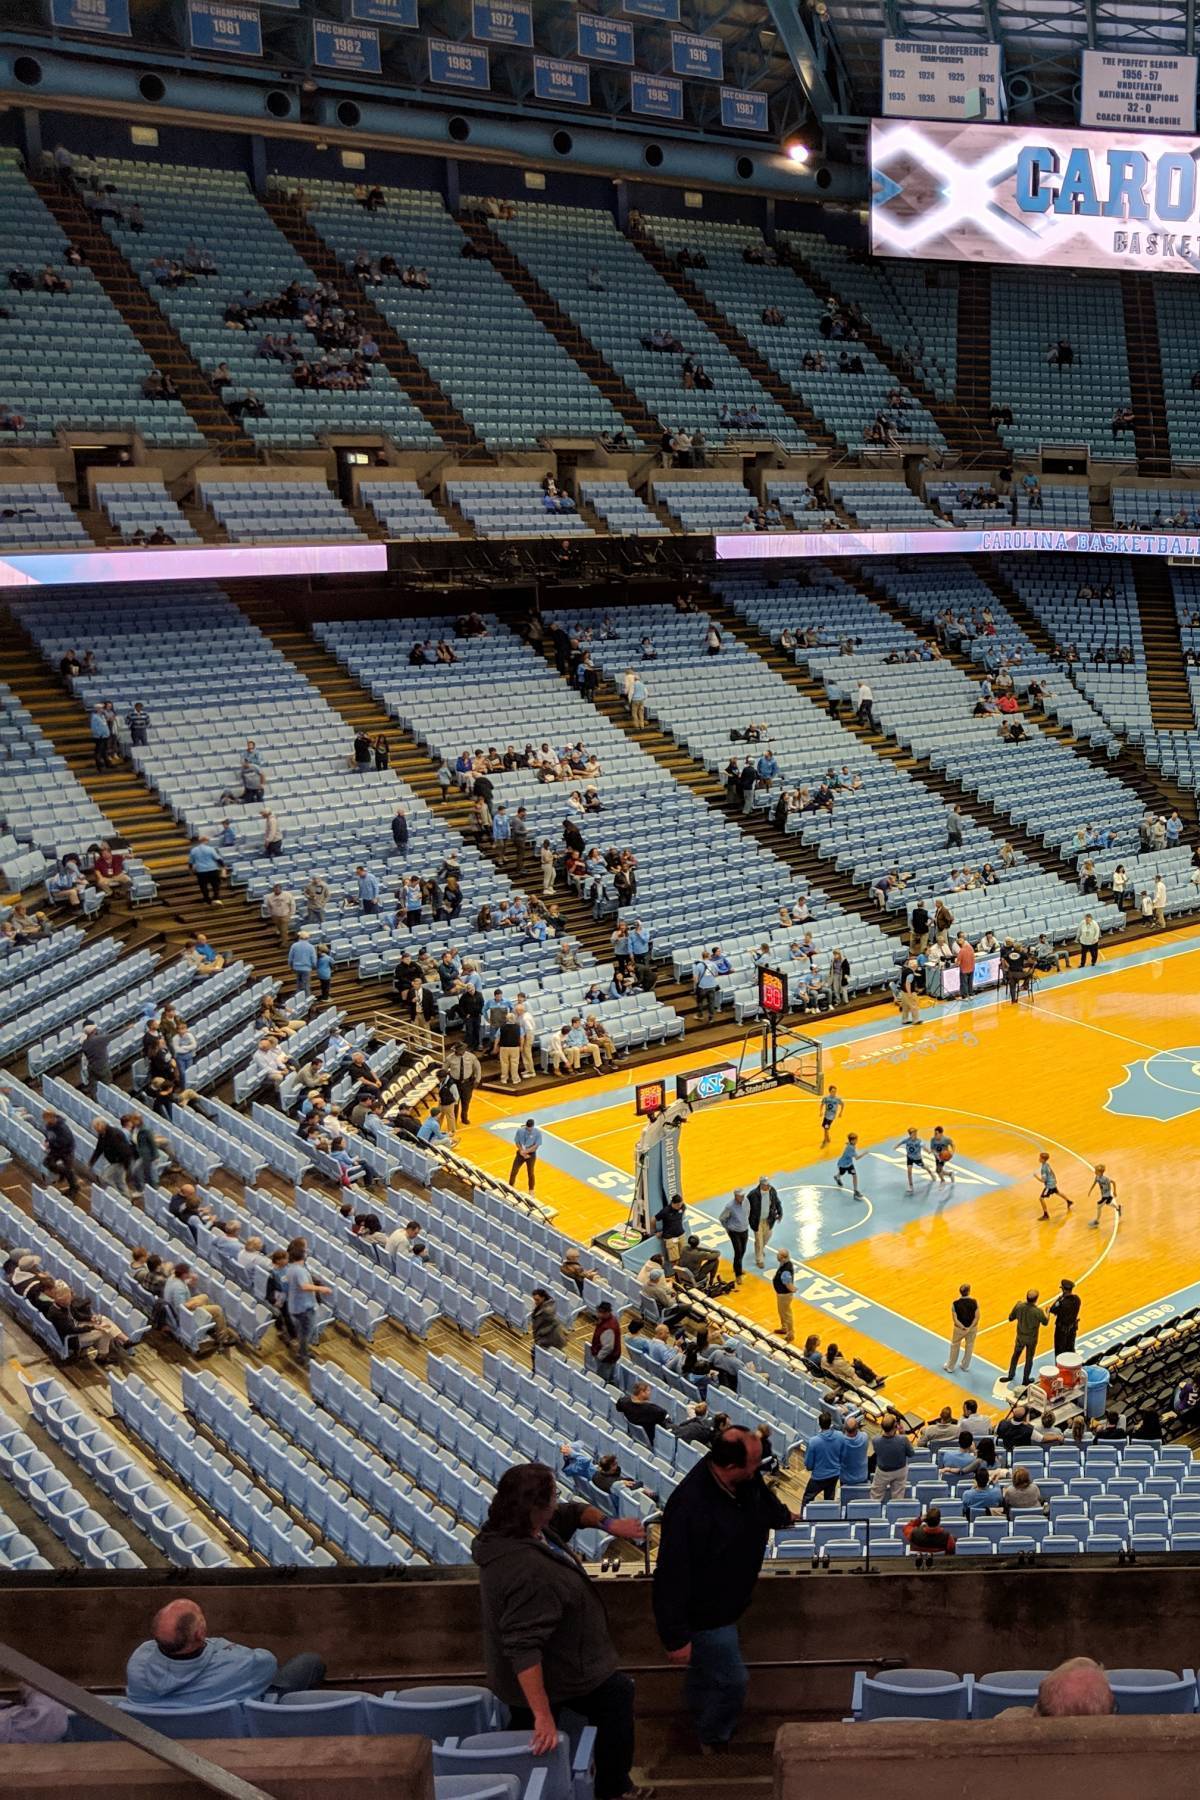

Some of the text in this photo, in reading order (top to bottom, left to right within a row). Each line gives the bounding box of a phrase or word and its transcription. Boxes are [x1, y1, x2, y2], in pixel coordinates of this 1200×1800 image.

[490, 12, 514, 28] 1972
[316, 23, 377, 41] ACC CHAMPIONS
[333, 37, 362, 54] 1982
[895, 42, 989, 57] SOUTHERN CONFERENCE
[1102, 57, 1178, 70] THE PERFECT SEASON
[889, 69, 905, 79] 1922
[1122, 69, 1142, 80] 1956
[1149, 70, 1159, 80] 57
[1117, 81, 1162, 91] UNDEFEATED
[1098, 90, 1179, 102] NATIONAL CHAMPIONS
[1127, 102, 1139, 112] 32
[1145, 103, 1152, 113] 0
[1123, 114, 1146, 124] FRANK
[982, 532, 1069, 550] CAROLINA
